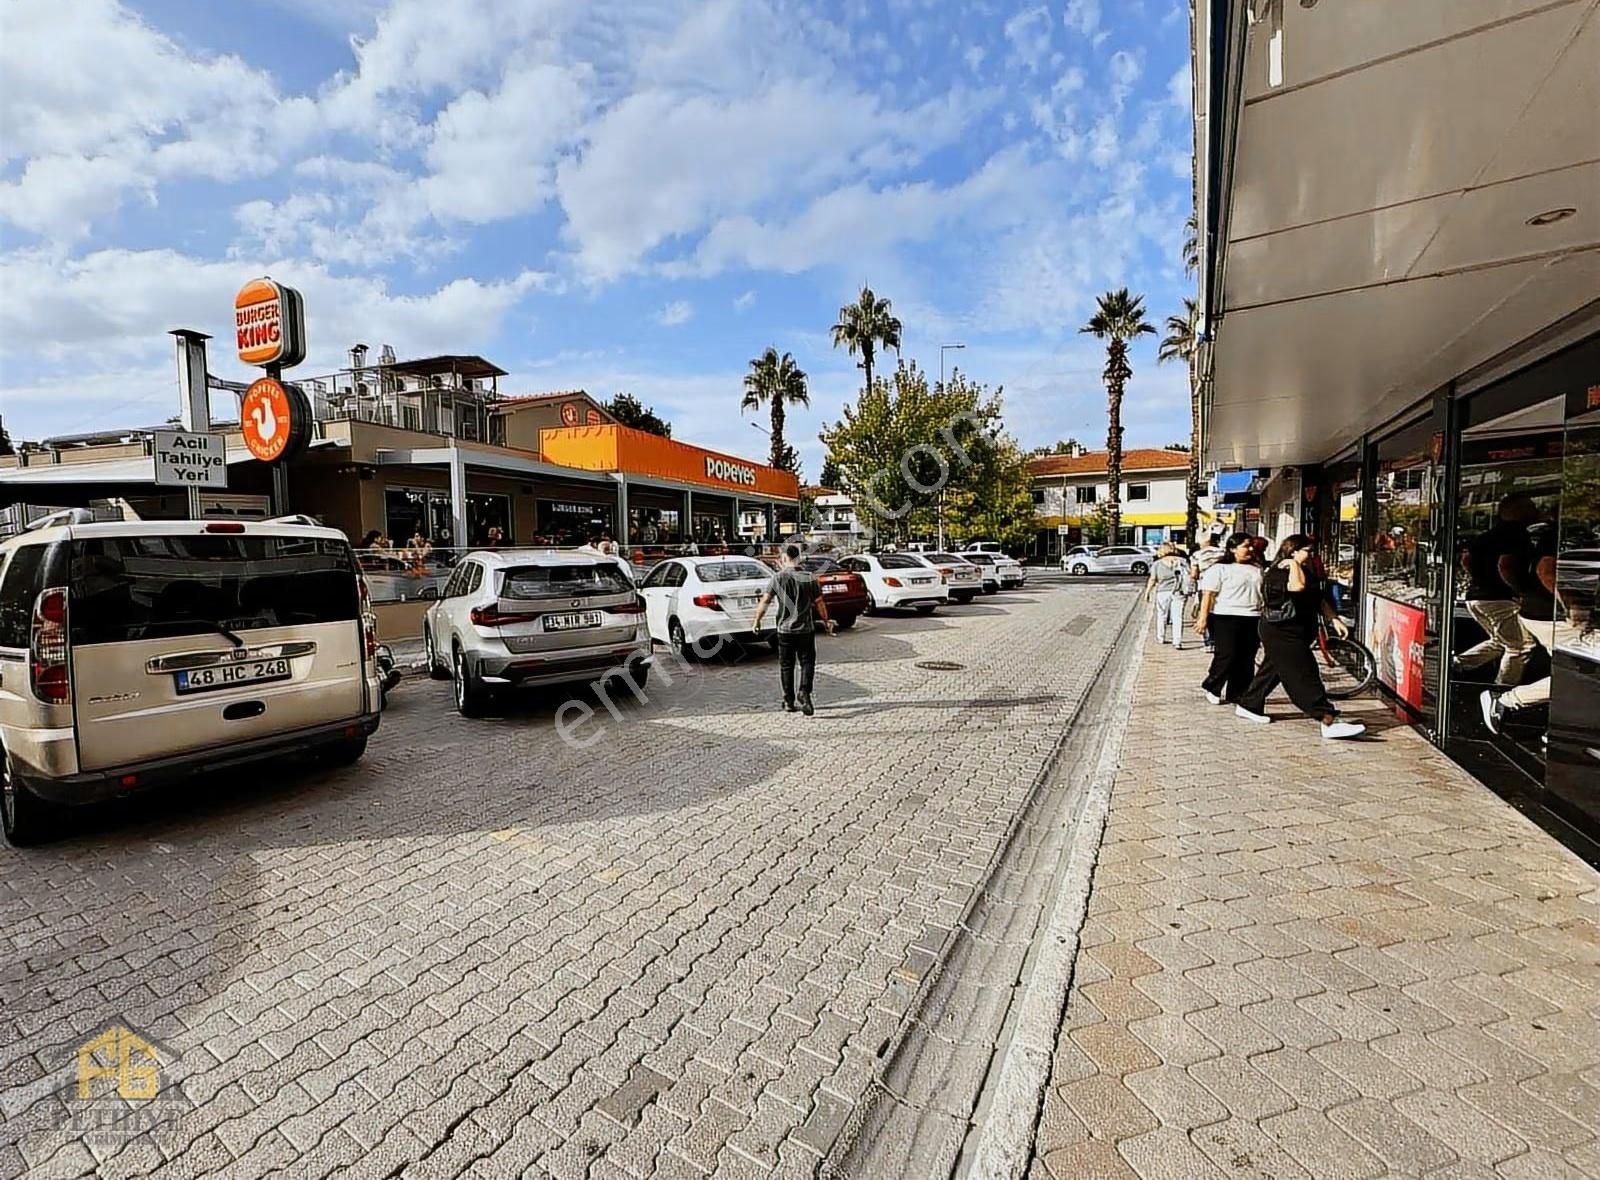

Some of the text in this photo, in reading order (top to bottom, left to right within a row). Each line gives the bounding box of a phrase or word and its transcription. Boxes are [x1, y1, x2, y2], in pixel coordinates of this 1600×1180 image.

[236, 304, 279, 326] BURGER
[237, 320, 280, 349] KING
[173, 436, 208, 449] Acil
[158, 451, 222, 468] Tahliye
[174, 468, 209, 481] Yeri
[190, 660, 287, 685] 48 HC 248
